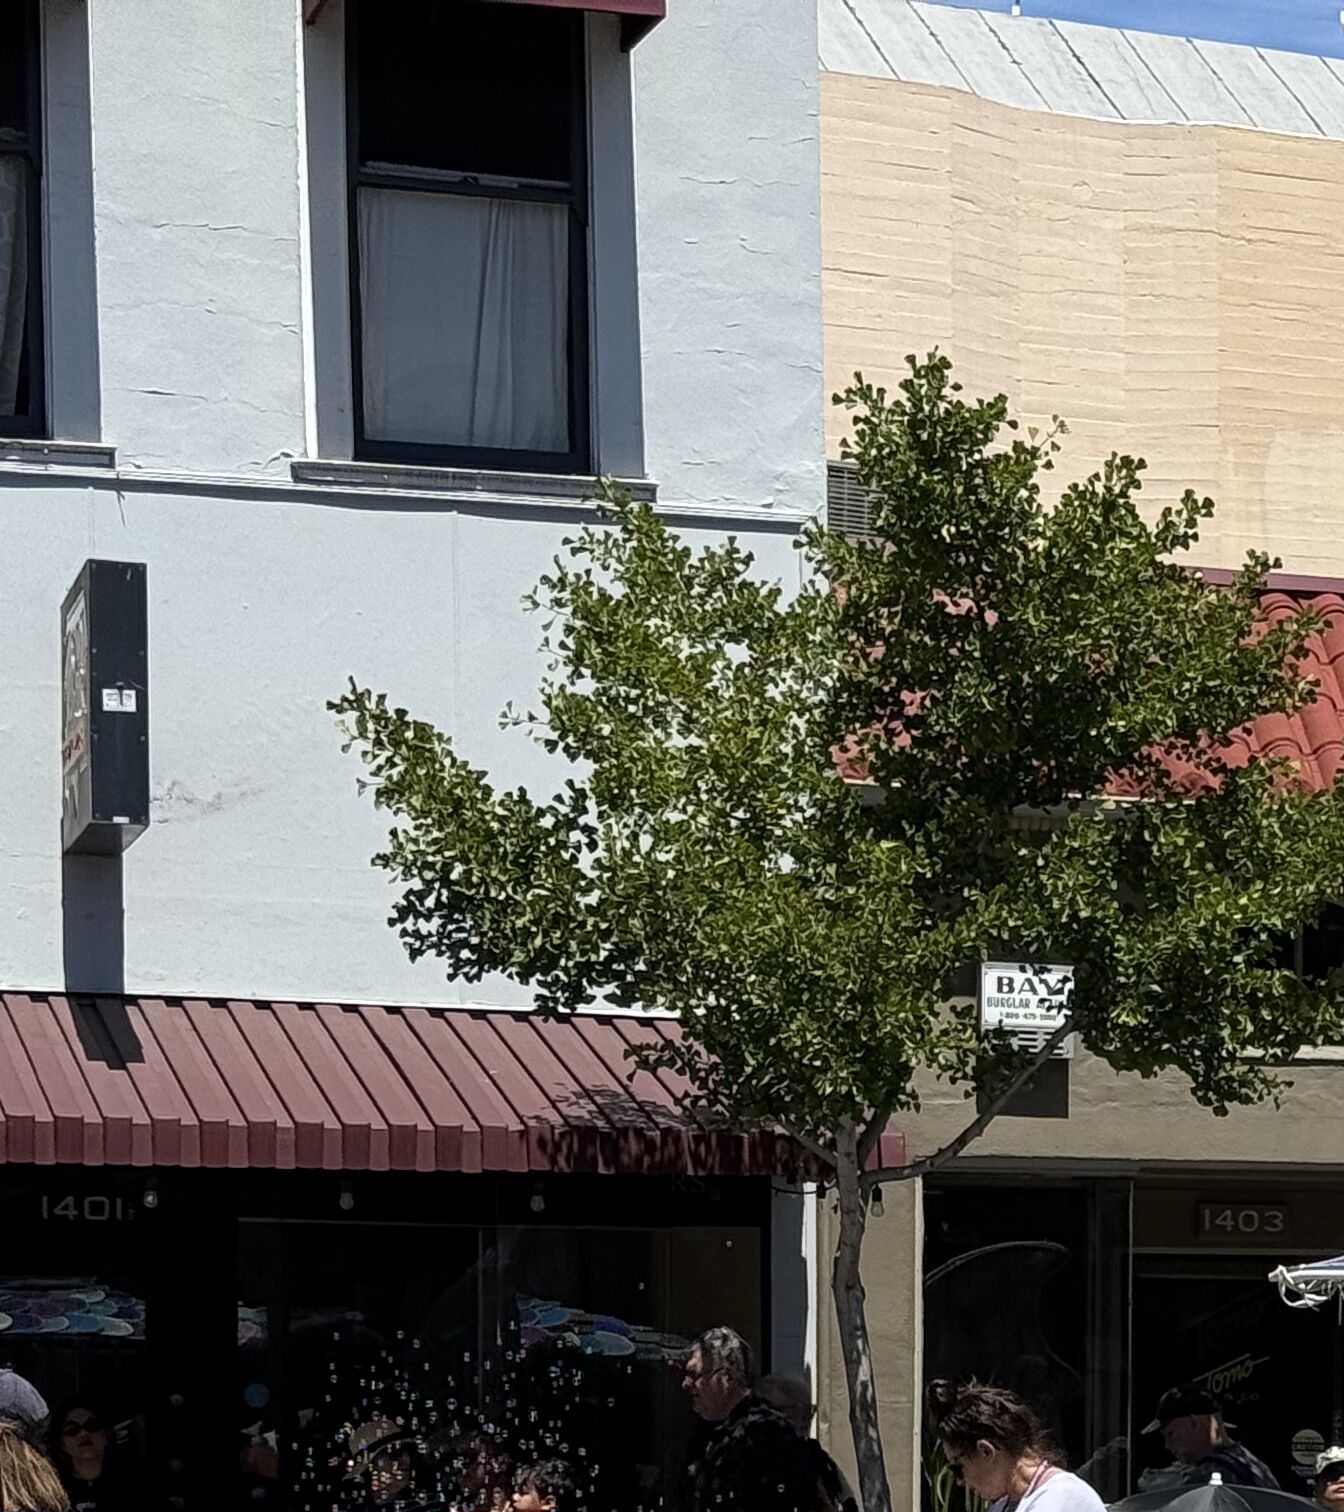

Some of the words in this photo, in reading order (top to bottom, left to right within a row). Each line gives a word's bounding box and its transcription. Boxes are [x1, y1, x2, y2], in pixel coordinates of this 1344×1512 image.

[996, 976, 1066, 996] BAY
[986, 996, 1031, 1009] BURGLAR
[42, 1195, 122, 1220] 1401
[1204, 1208, 1284, 1232] 1403
[1192, 1352, 1272, 1394] Tomo
